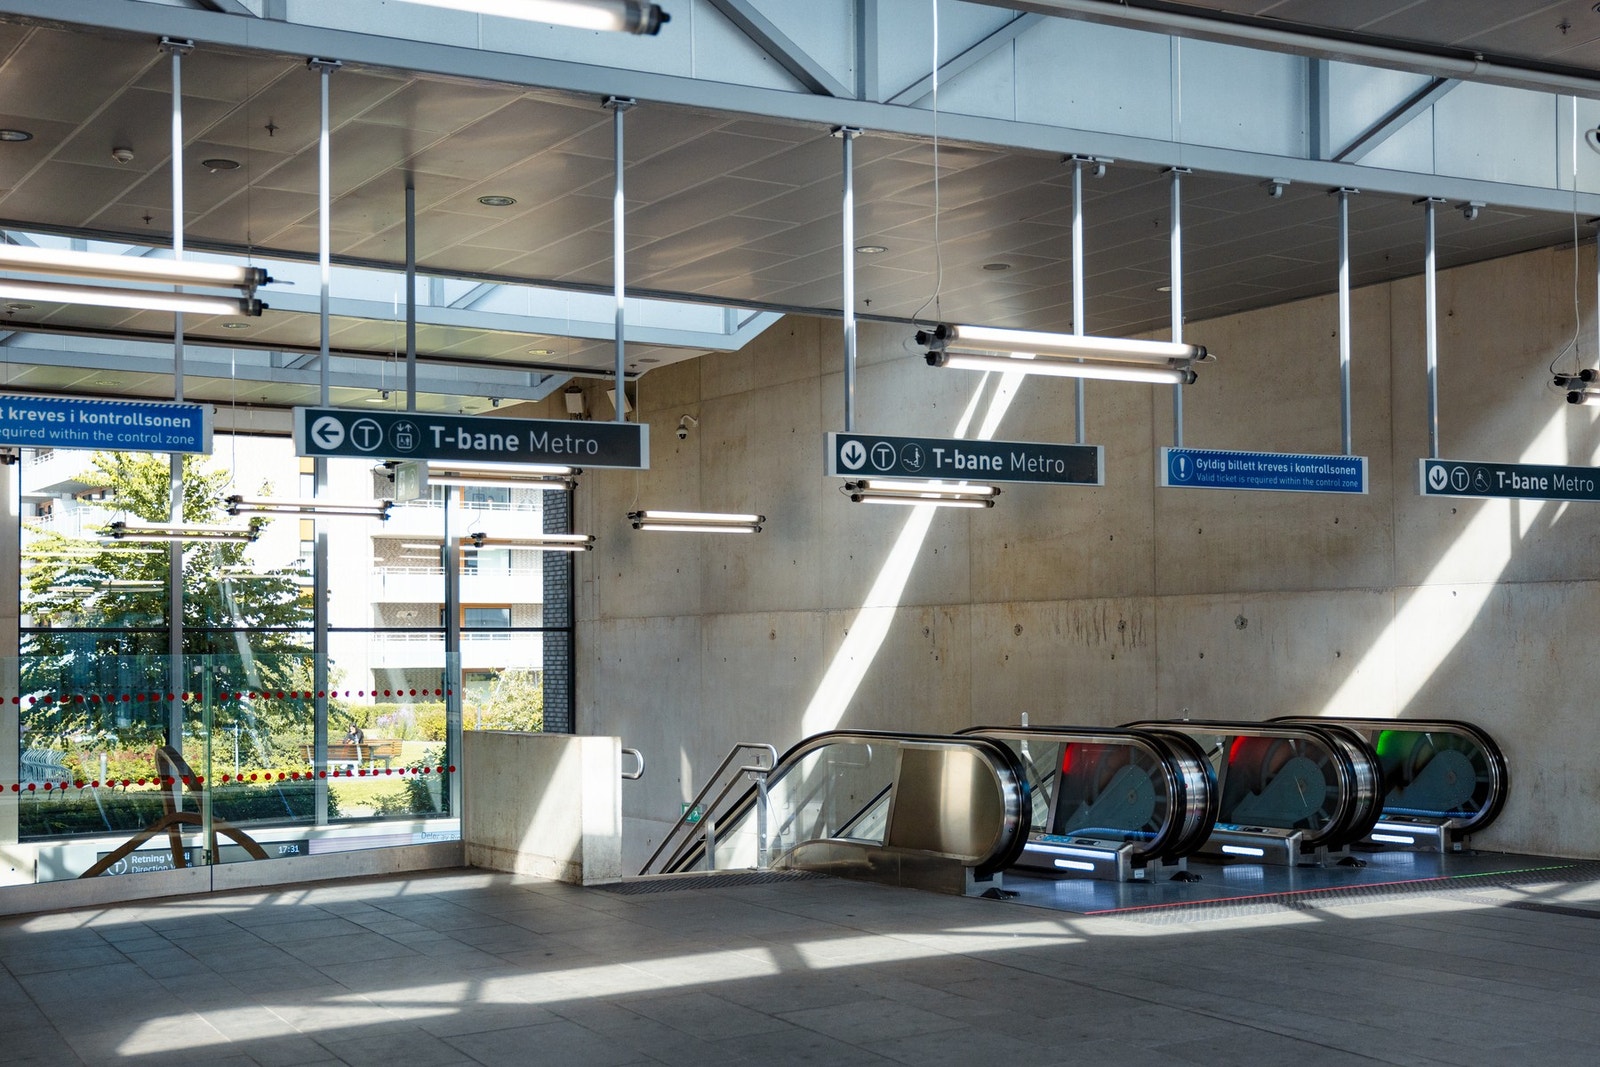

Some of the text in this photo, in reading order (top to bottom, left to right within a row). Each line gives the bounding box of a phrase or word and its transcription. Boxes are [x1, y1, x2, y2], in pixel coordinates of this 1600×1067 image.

[9, 406, 65, 422] kreves
[71, 409, 75, 422] i
[80, 410, 191, 428] kontrollsonen
[0, 426, 195, 445] quired within the control zone
[430, 425, 519, 452] T-bane
[530, 431, 599, 455] Metro
[932, 448, 1003, 471] T-bane
[1011, 452, 1065, 474] Metro
[1196, 458, 1357, 475] Gyldig billett kreves i kontrollsonen
[1196, 472, 1359, 488] Valid ticket is required within the control zone
[1496, 471, 1548, 490] T-bane
[1553, 474, 1594, 492] Metro
[278, 845, 300, 854] 17:31
[131, 854, 165, 864] Retning
[131, 864, 168, 873] Direction
